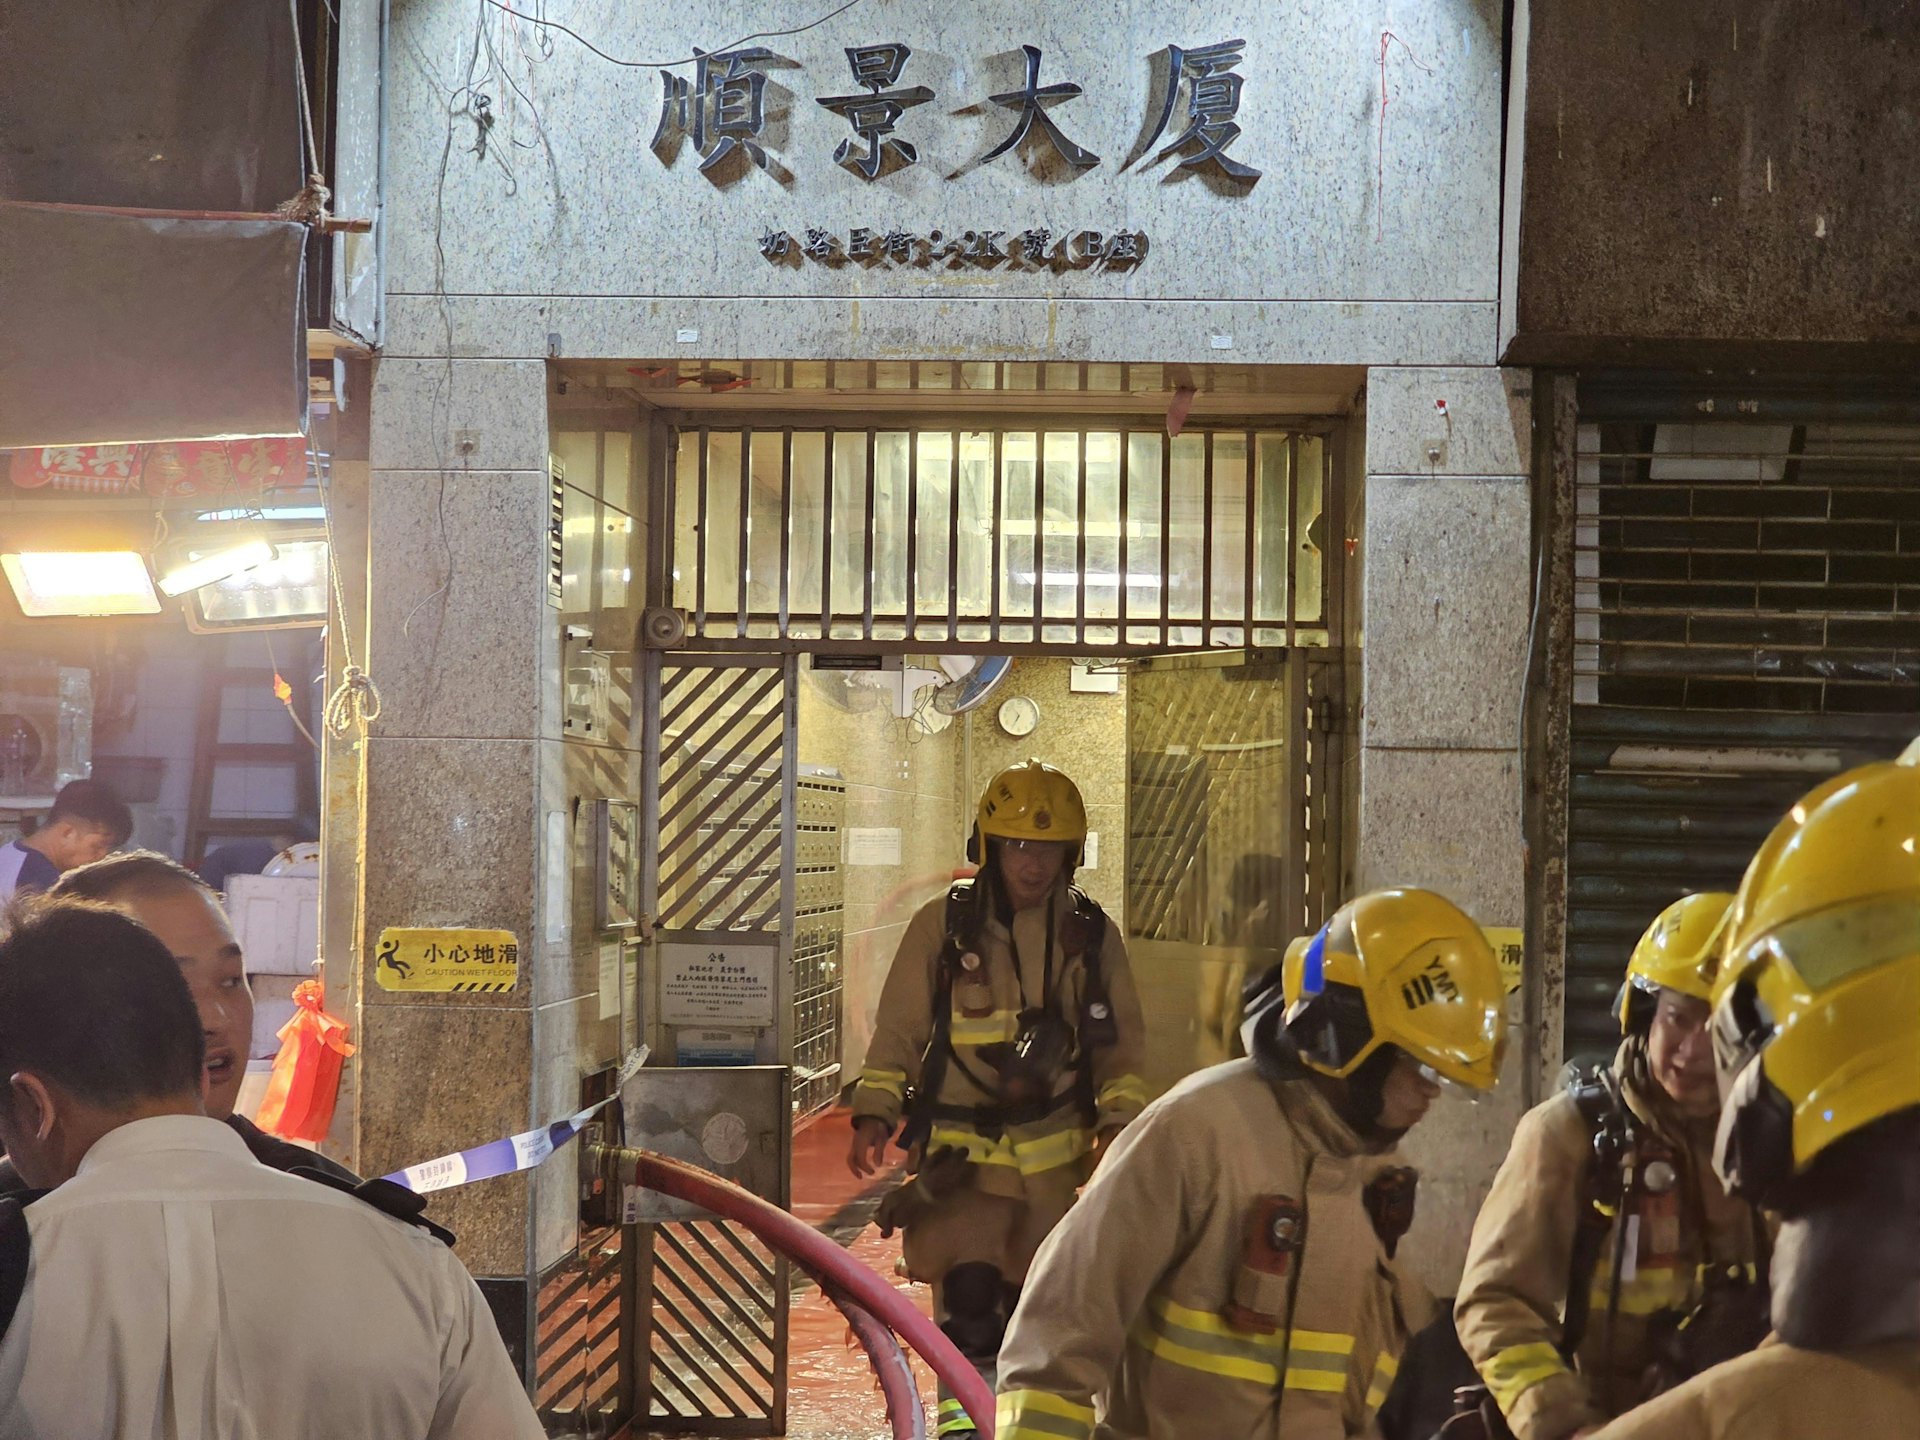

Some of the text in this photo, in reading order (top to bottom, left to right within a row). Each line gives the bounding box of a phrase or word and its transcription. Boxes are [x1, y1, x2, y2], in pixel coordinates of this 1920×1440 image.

[424, 943, 518, 965] 小心地滑
[425, 968, 517, 977] CAUTION WET FLOOR
